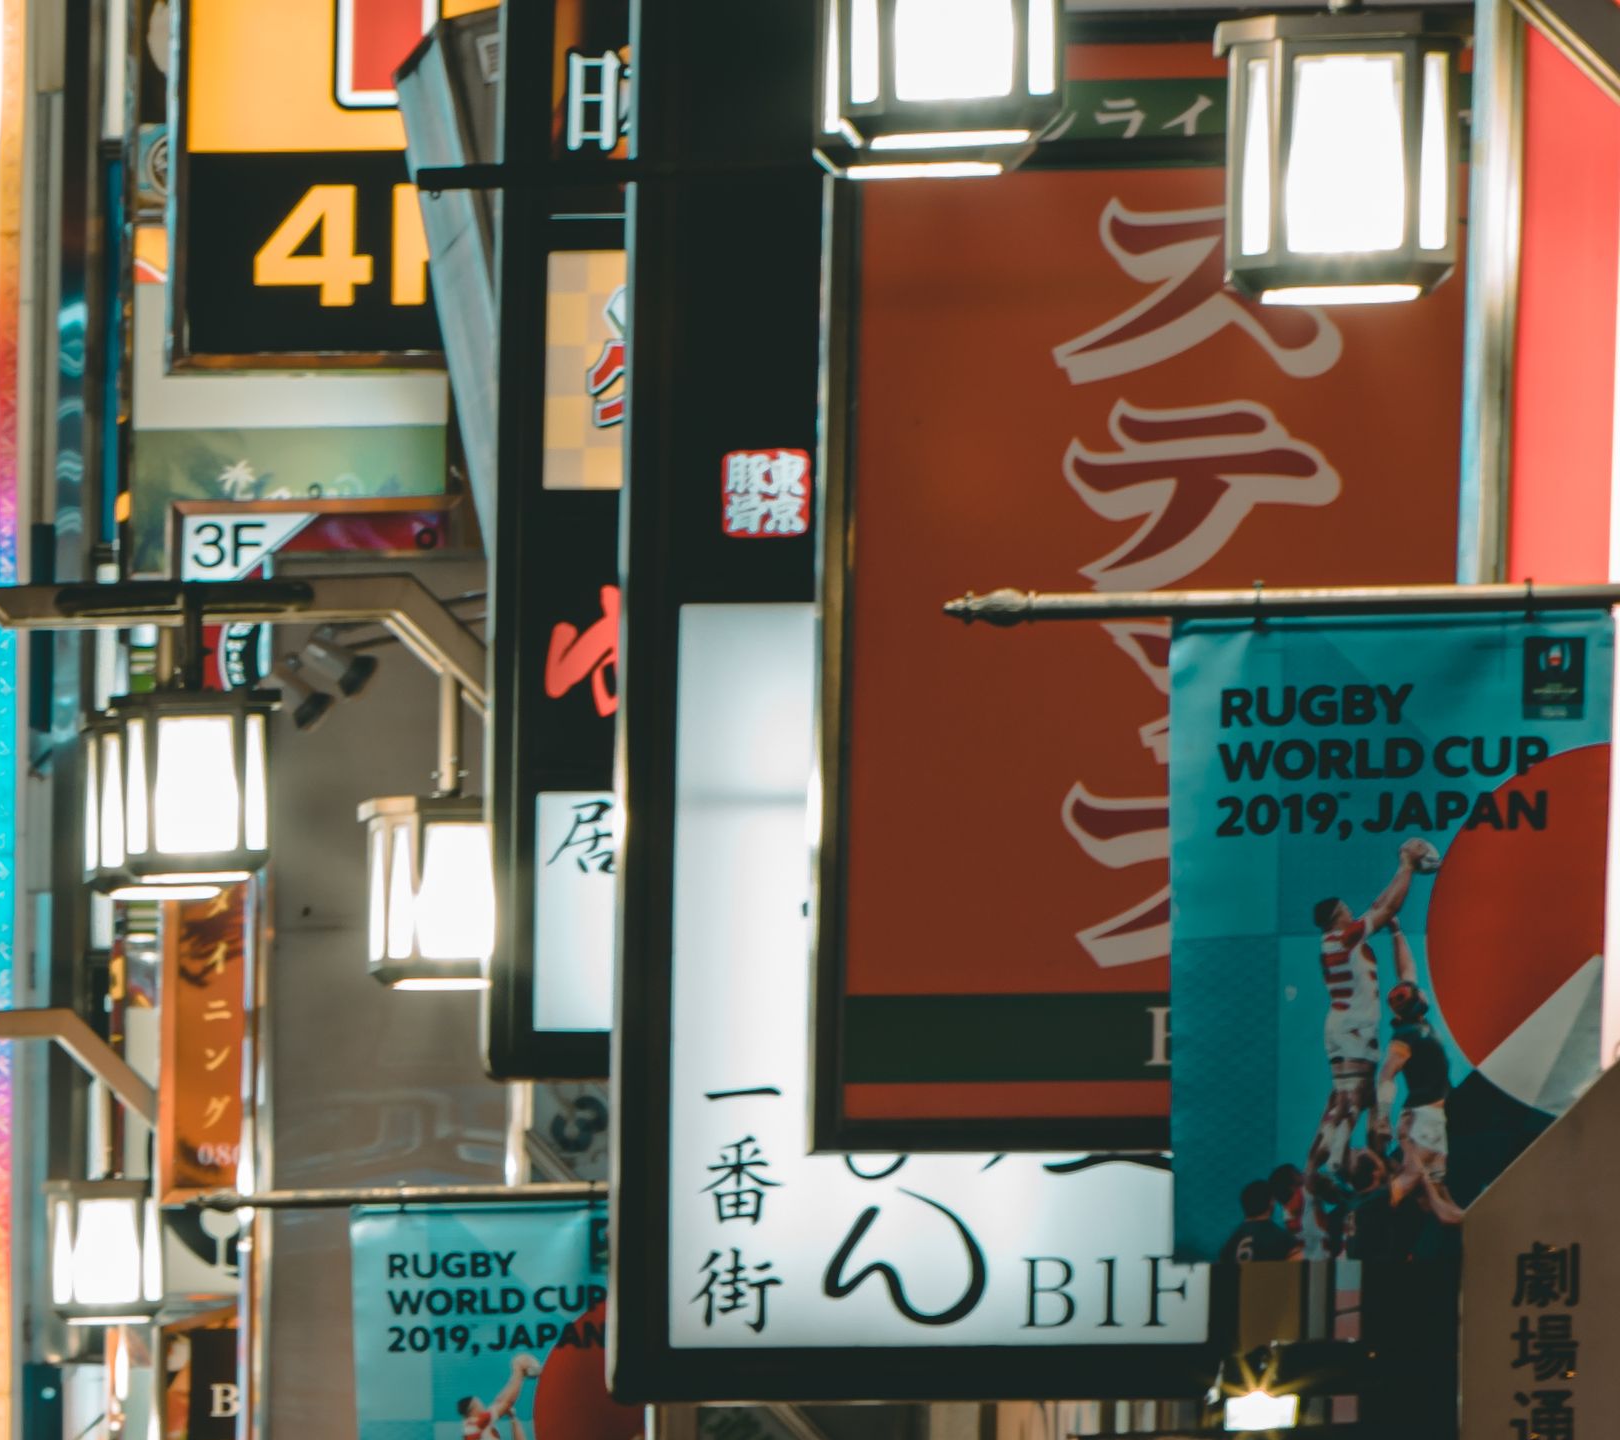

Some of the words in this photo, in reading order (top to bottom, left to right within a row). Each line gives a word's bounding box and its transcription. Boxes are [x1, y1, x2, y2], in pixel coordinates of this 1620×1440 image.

[190, 524, 268, 570] 3F
[1218, 682, 1416, 730] RUGBY
[1218, 738, 1426, 782] WORLD
[1432, 735, 1550, 778] CUP
[1362, 789, 1550, 833] JAPAN
[692, 1084, 784, 1336] 一番街
[386, 1251, 518, 1279] RUGBY
[386, 1286, 526, 1316] WORLD
[532, 1284, 608, 1314] CUP
[1022, 1256, 1192, 1329] B1F
[487, 1321, 606, 1352] JAPAN
